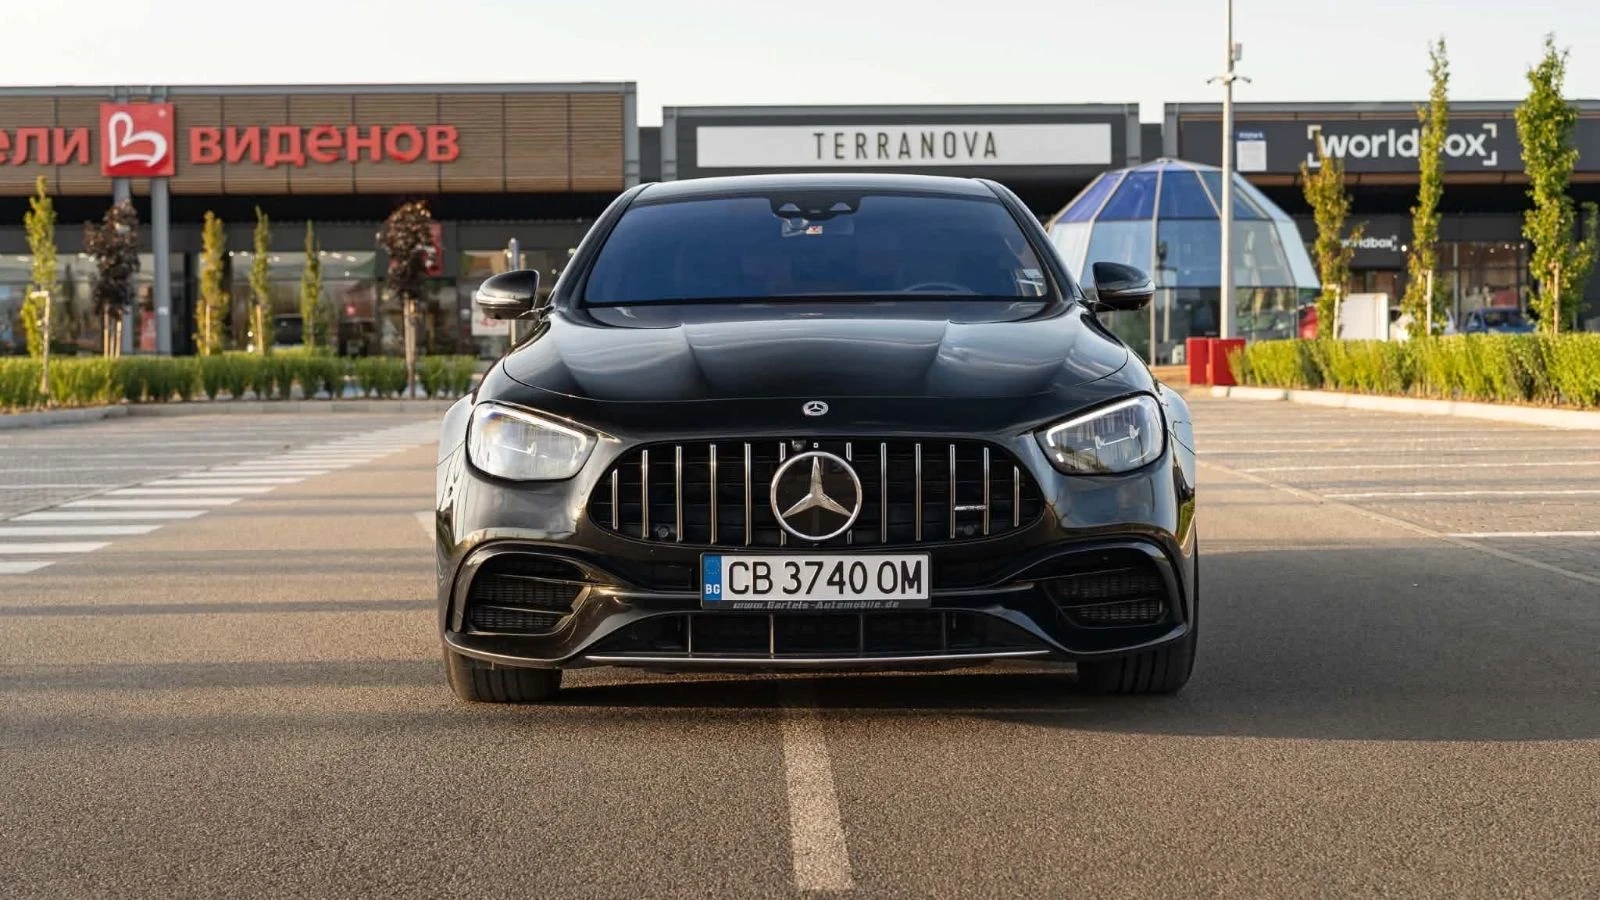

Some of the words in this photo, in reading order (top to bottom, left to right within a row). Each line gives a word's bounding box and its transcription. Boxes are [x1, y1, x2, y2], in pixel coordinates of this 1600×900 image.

[189, 124, 460, 167] виденов
[813, 130, 998, 159] TERRANOVA
[1318, 127, 1488, 158] worldox
[705, 583, 721, 595] BG
[728, 560, 773, 595] CB
[782, 560, 868, 595] 3740
[877, 560, 922, 595] OM
